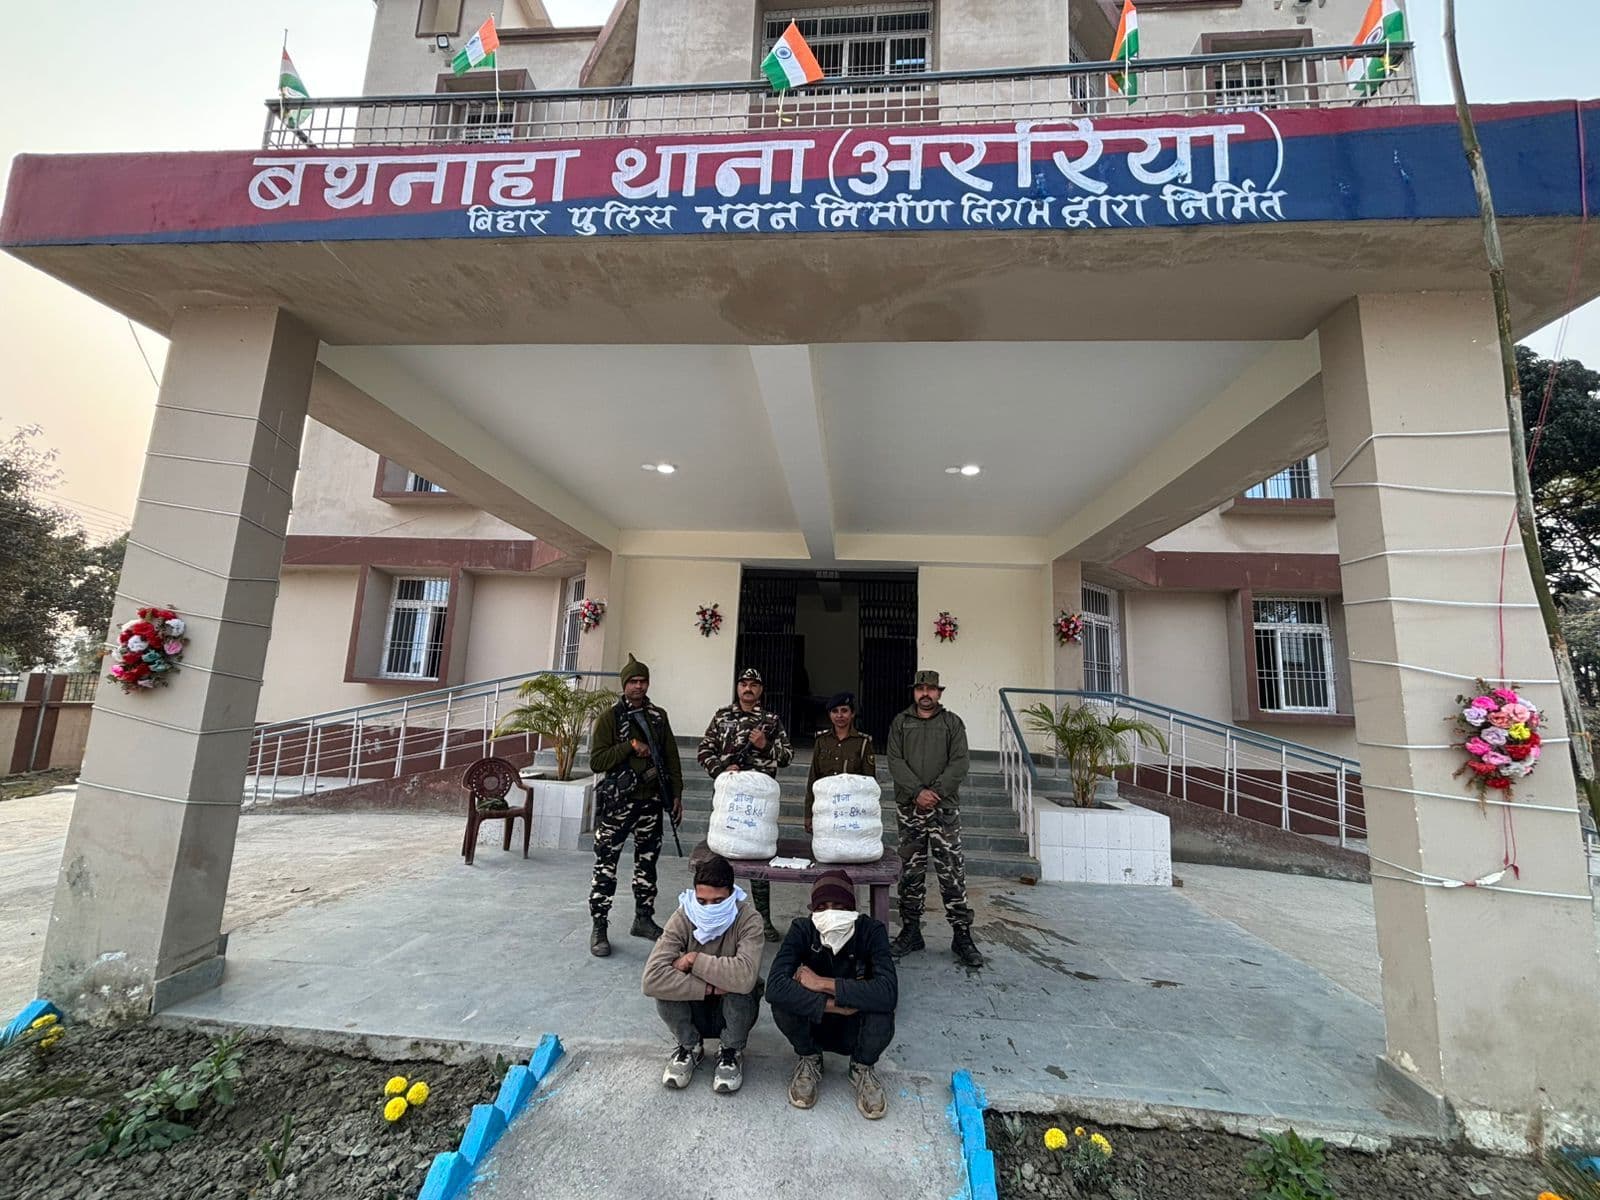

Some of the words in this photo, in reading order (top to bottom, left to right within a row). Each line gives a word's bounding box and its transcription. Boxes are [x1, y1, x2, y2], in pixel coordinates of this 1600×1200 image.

[248, 149, 581, 210] बथनाहा
[611, 139, 815, 199] थाना
[467, 205, 551, 234] बिहार
[567, 200, 677, 236] पुलिस
[695, 200, 805, 232] भवन
[812, 192, 956, 230] निर्माण
[961, 192, 1056, 226] निगम
[1061, 193, 1150, 228] द्वारा
[1159, 179, 1288, 223] निर्मित
